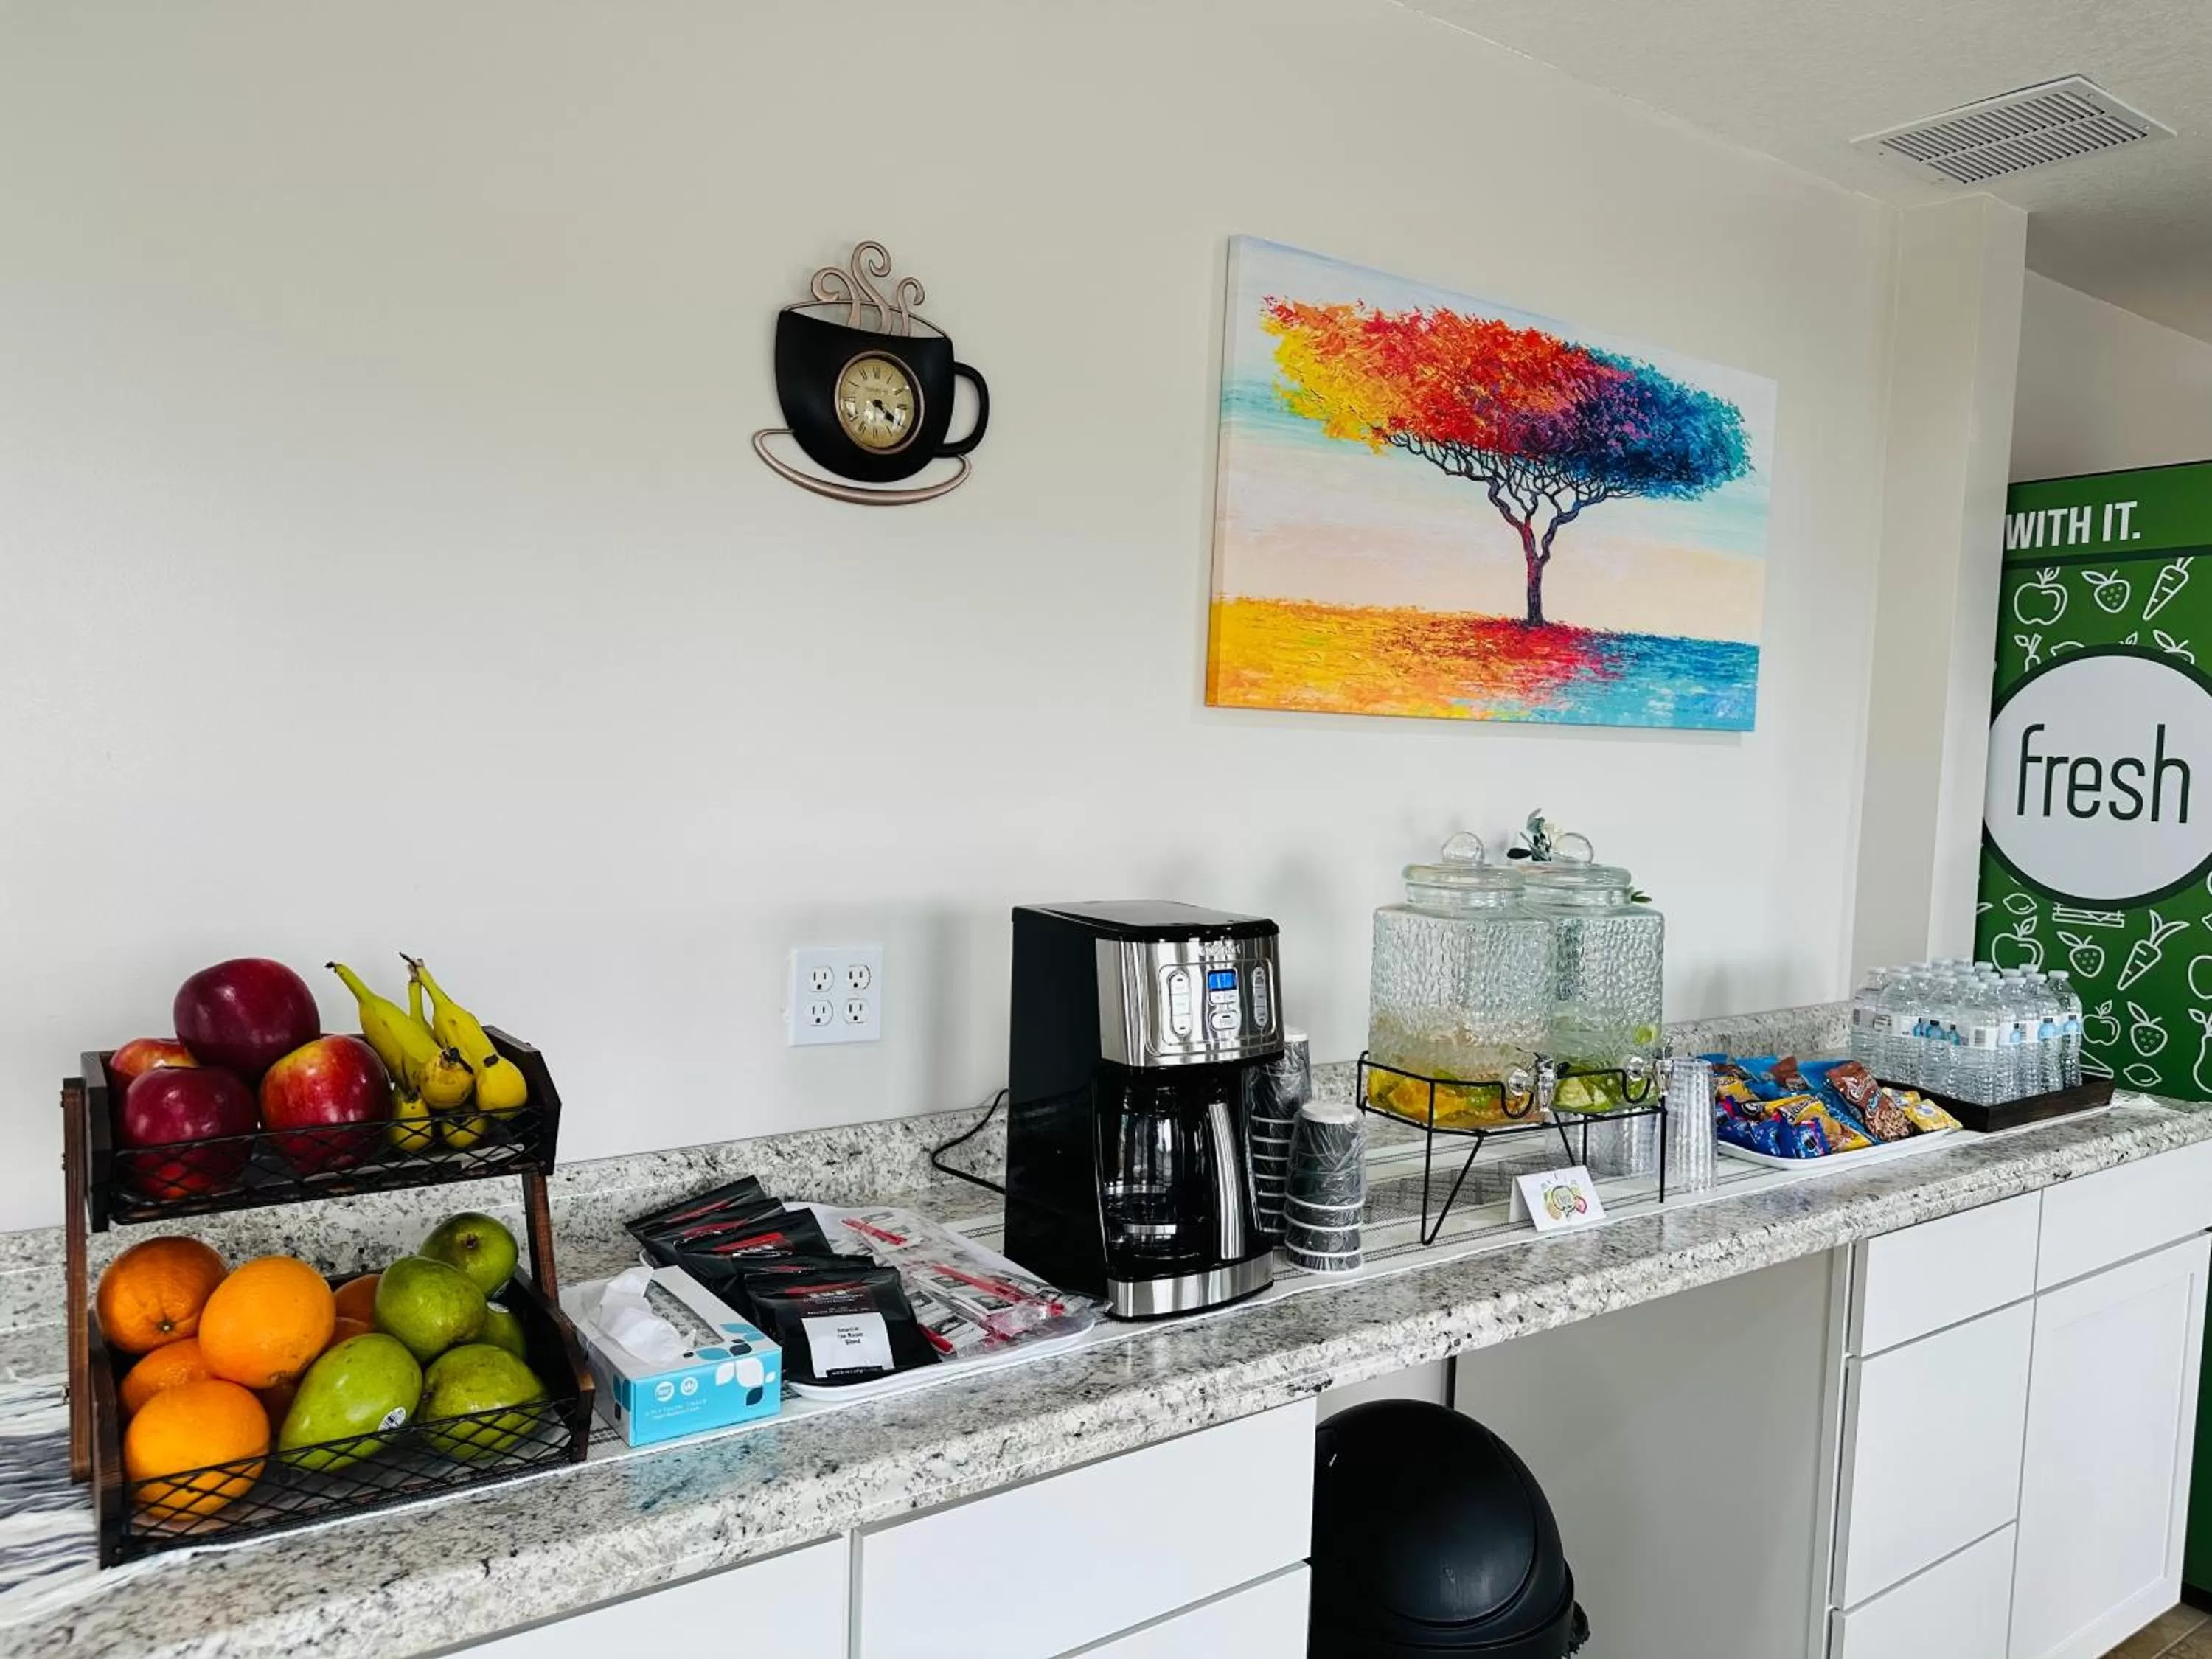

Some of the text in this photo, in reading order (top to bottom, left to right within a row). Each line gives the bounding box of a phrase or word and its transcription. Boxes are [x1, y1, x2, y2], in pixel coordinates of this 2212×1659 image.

[2006, 501, 2141, 551] WITH IT.
[2016, 723, 2191, 824] fresh
